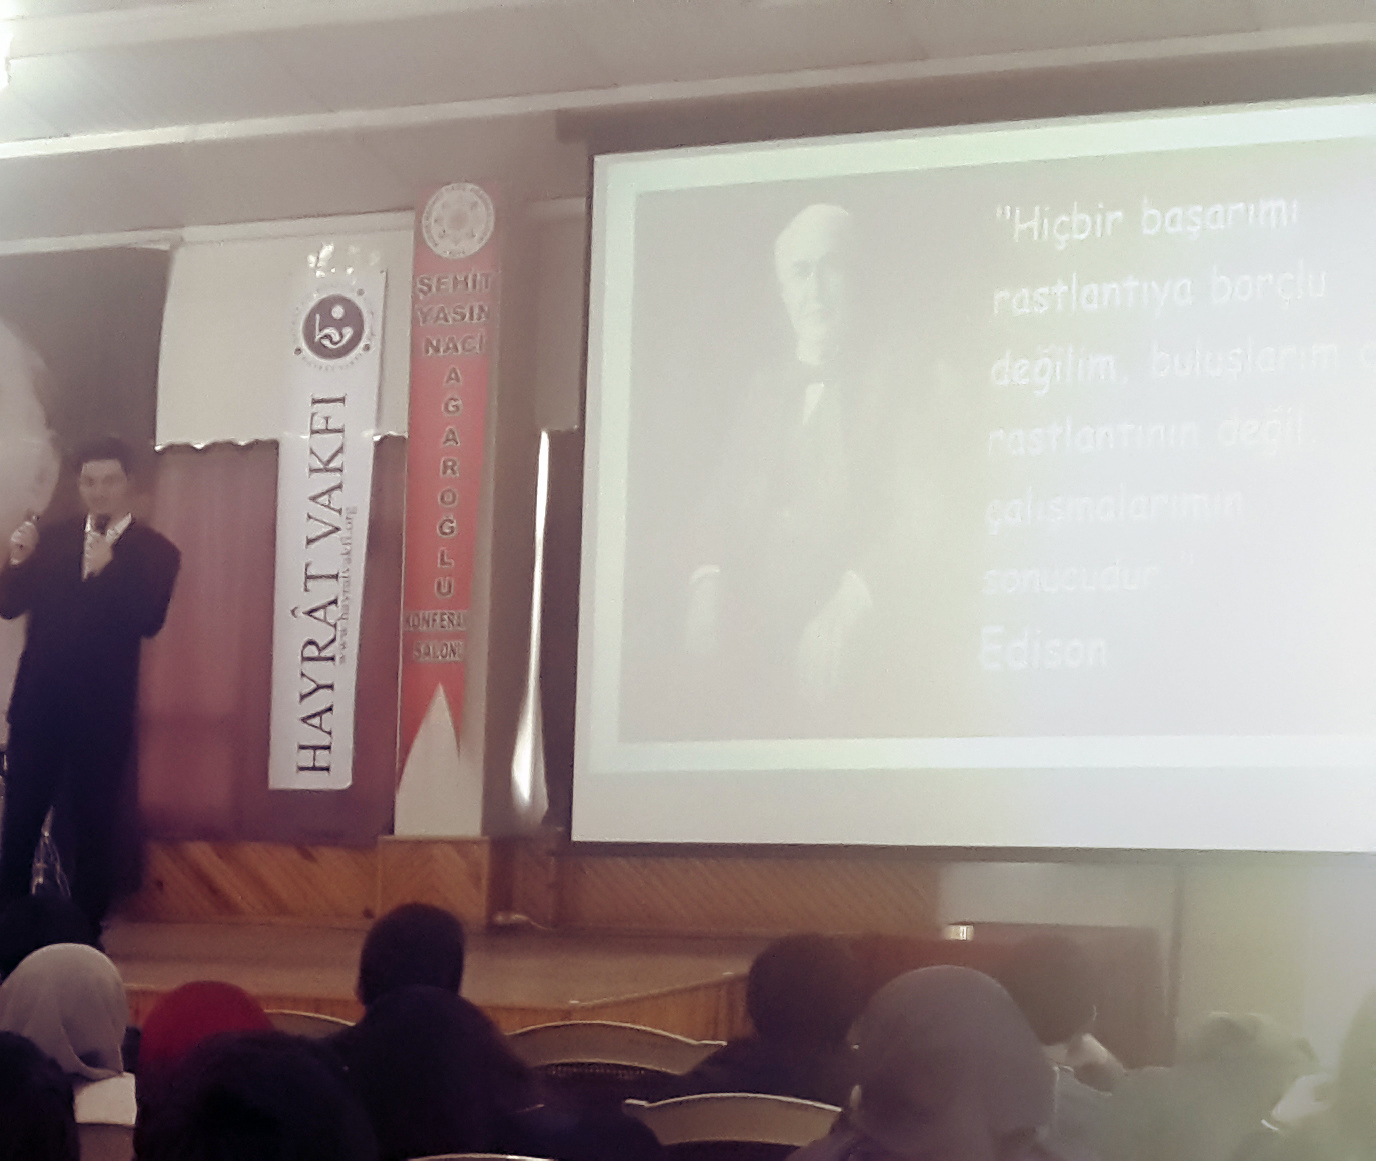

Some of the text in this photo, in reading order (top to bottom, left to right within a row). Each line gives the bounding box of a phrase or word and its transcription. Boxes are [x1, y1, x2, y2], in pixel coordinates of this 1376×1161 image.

[1211, 257, 1328, 311] borçlu
[305, 393, 348, 550] VAKFI
[291, 563, 340, 776] HAYRÂT
[978, 623, 1109, 671] Edison
